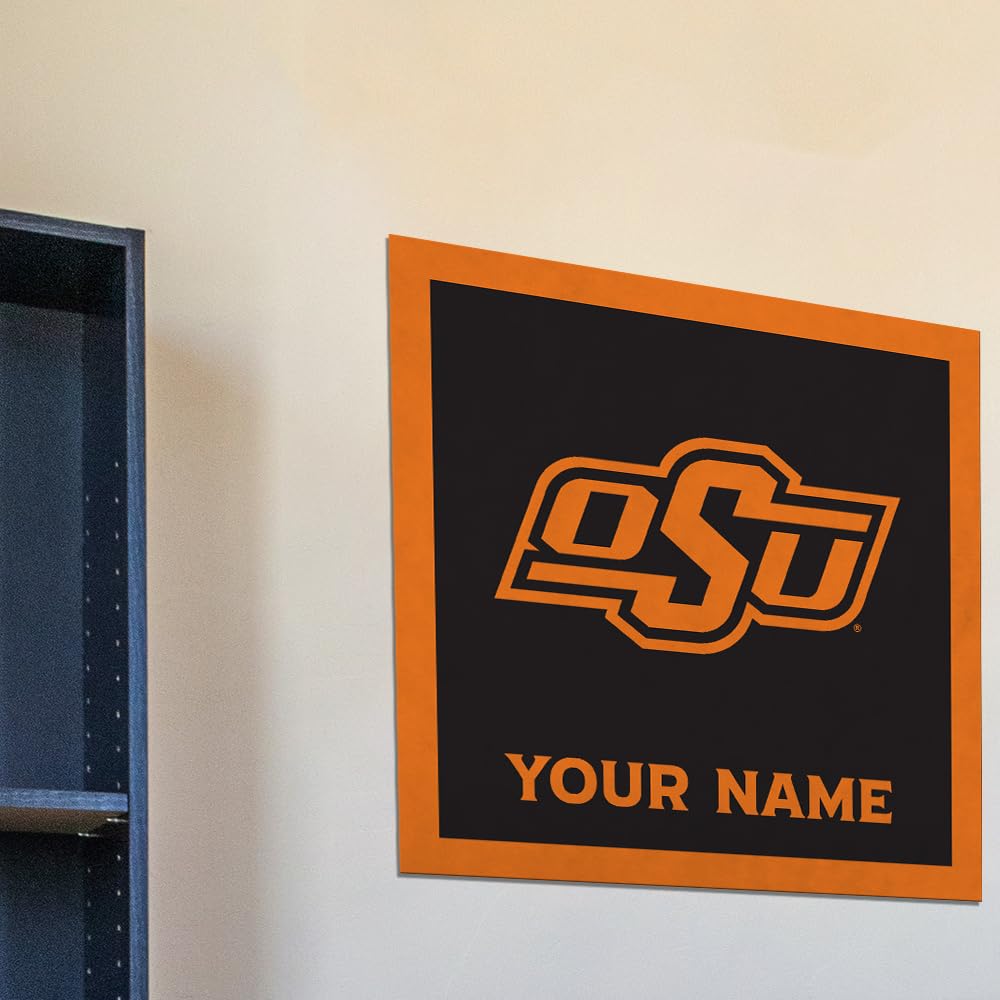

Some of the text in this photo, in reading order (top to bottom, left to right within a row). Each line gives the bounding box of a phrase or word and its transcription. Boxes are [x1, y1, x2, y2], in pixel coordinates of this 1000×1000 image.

[527, 460, 872, 632] OSU
[505, 753, 893, 824] YOUR NAME
